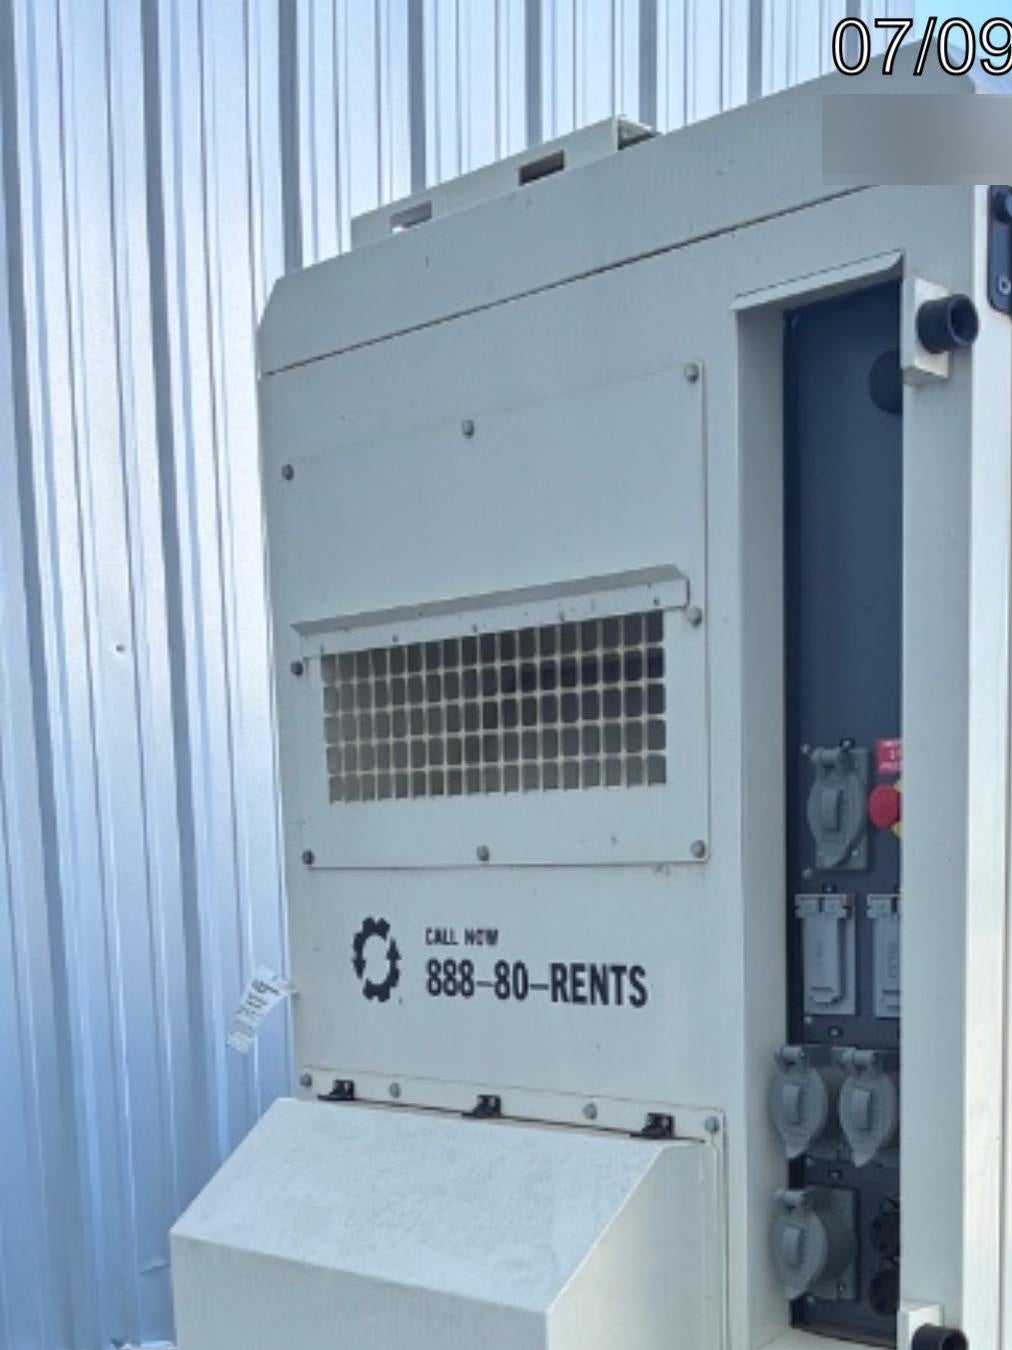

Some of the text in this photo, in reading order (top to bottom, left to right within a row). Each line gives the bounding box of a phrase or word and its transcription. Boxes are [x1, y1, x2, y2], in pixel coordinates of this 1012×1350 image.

[425, 928, 499, 947] CALL NOW
[426, 959, 648, 1009] 888-80-RENTS
